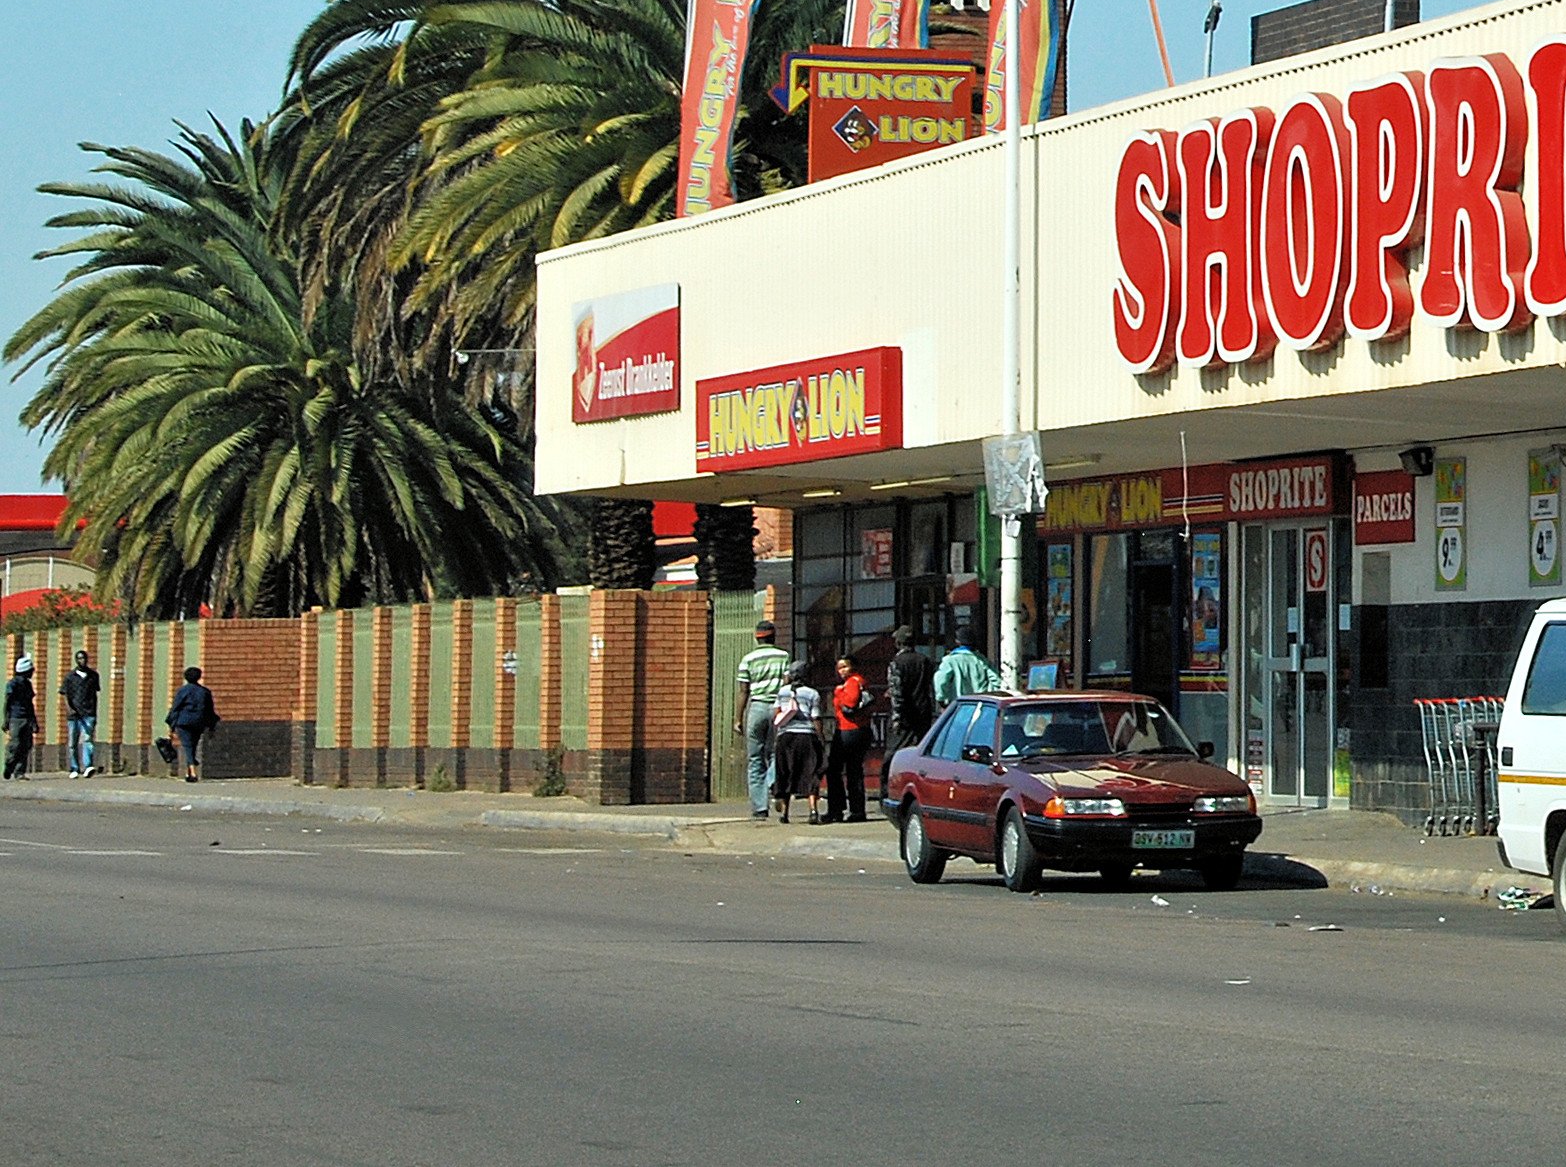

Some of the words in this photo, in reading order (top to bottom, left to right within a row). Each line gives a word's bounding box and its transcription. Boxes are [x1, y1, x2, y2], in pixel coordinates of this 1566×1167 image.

[818, 71, 966, 102] HUNGRY
[878, 115, 966, 144] LION
[709, 380, 798, 457] HUNGRY
[808, 367, 865, 443] LION
[1044, 481, 1113, 530] HUNGRY
[1120, 476, 1162, 525] LION
[1229, 465, 1328, 513] SHOPRITE
[1356, 492, 1412, 523] PARCELS
